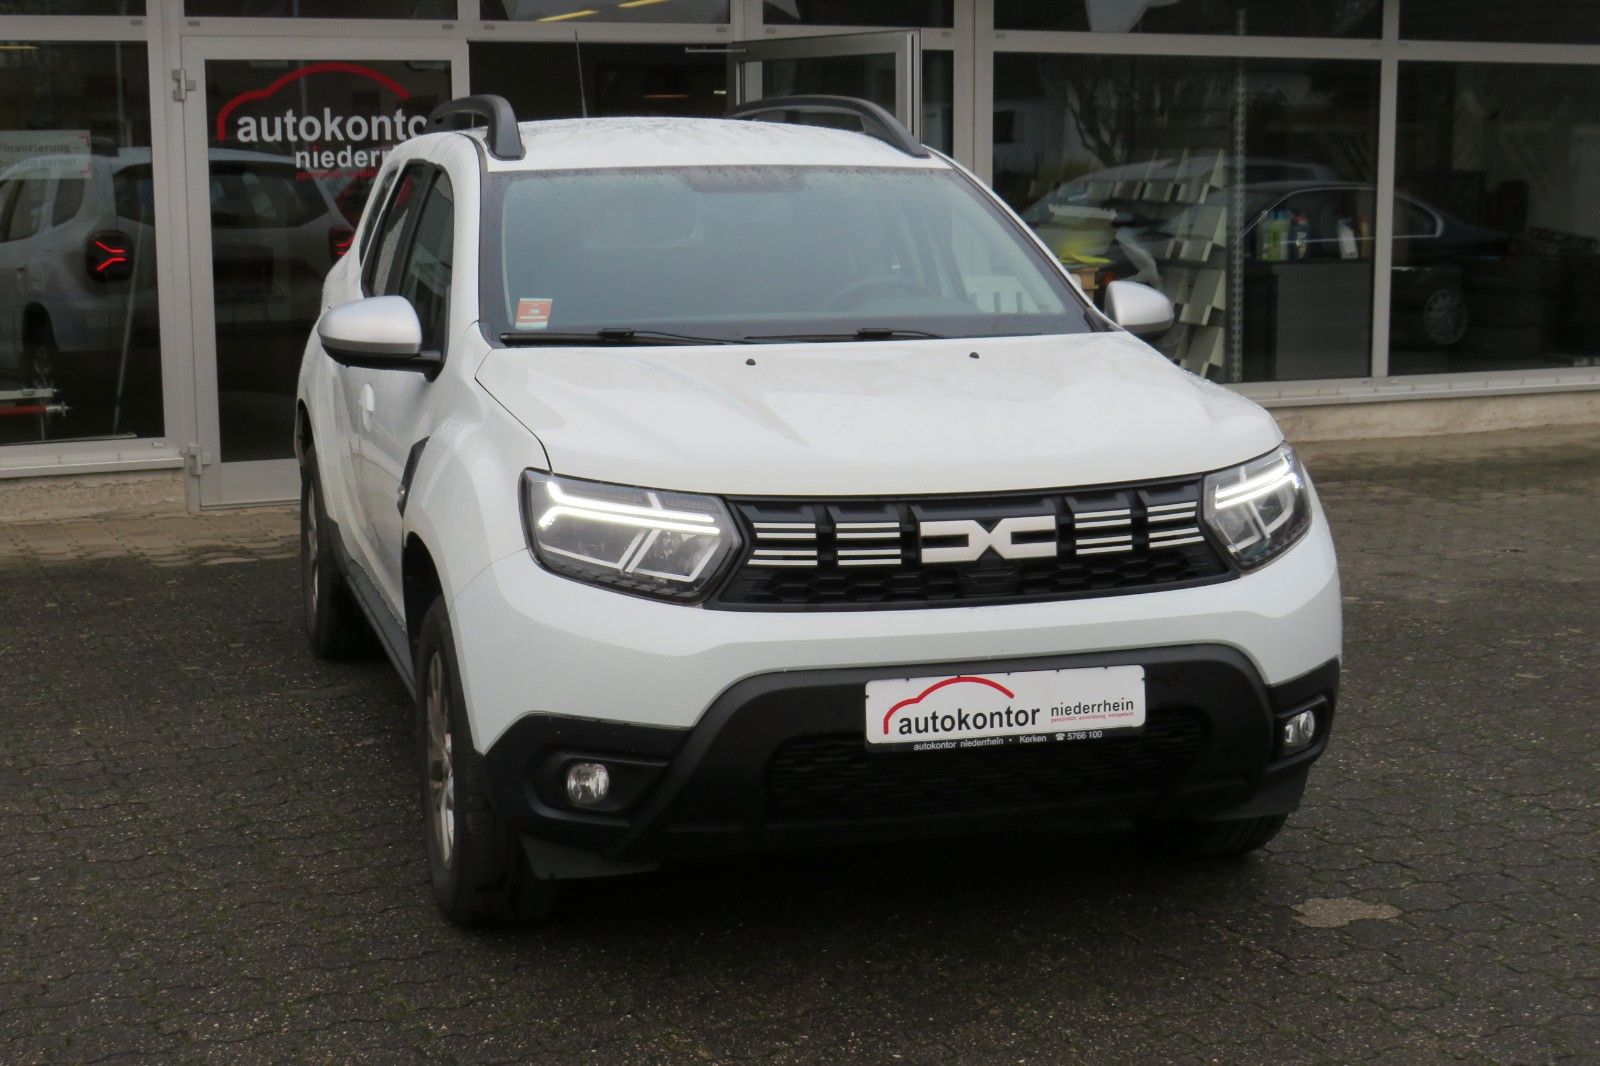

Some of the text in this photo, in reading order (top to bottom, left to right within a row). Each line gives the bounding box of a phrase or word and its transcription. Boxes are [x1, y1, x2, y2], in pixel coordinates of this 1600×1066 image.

[898, 697, 1134, 735] autokontor niederrhein
[913, 730, 1103, 751] autokontor niederrhein Kerken 5766 100
